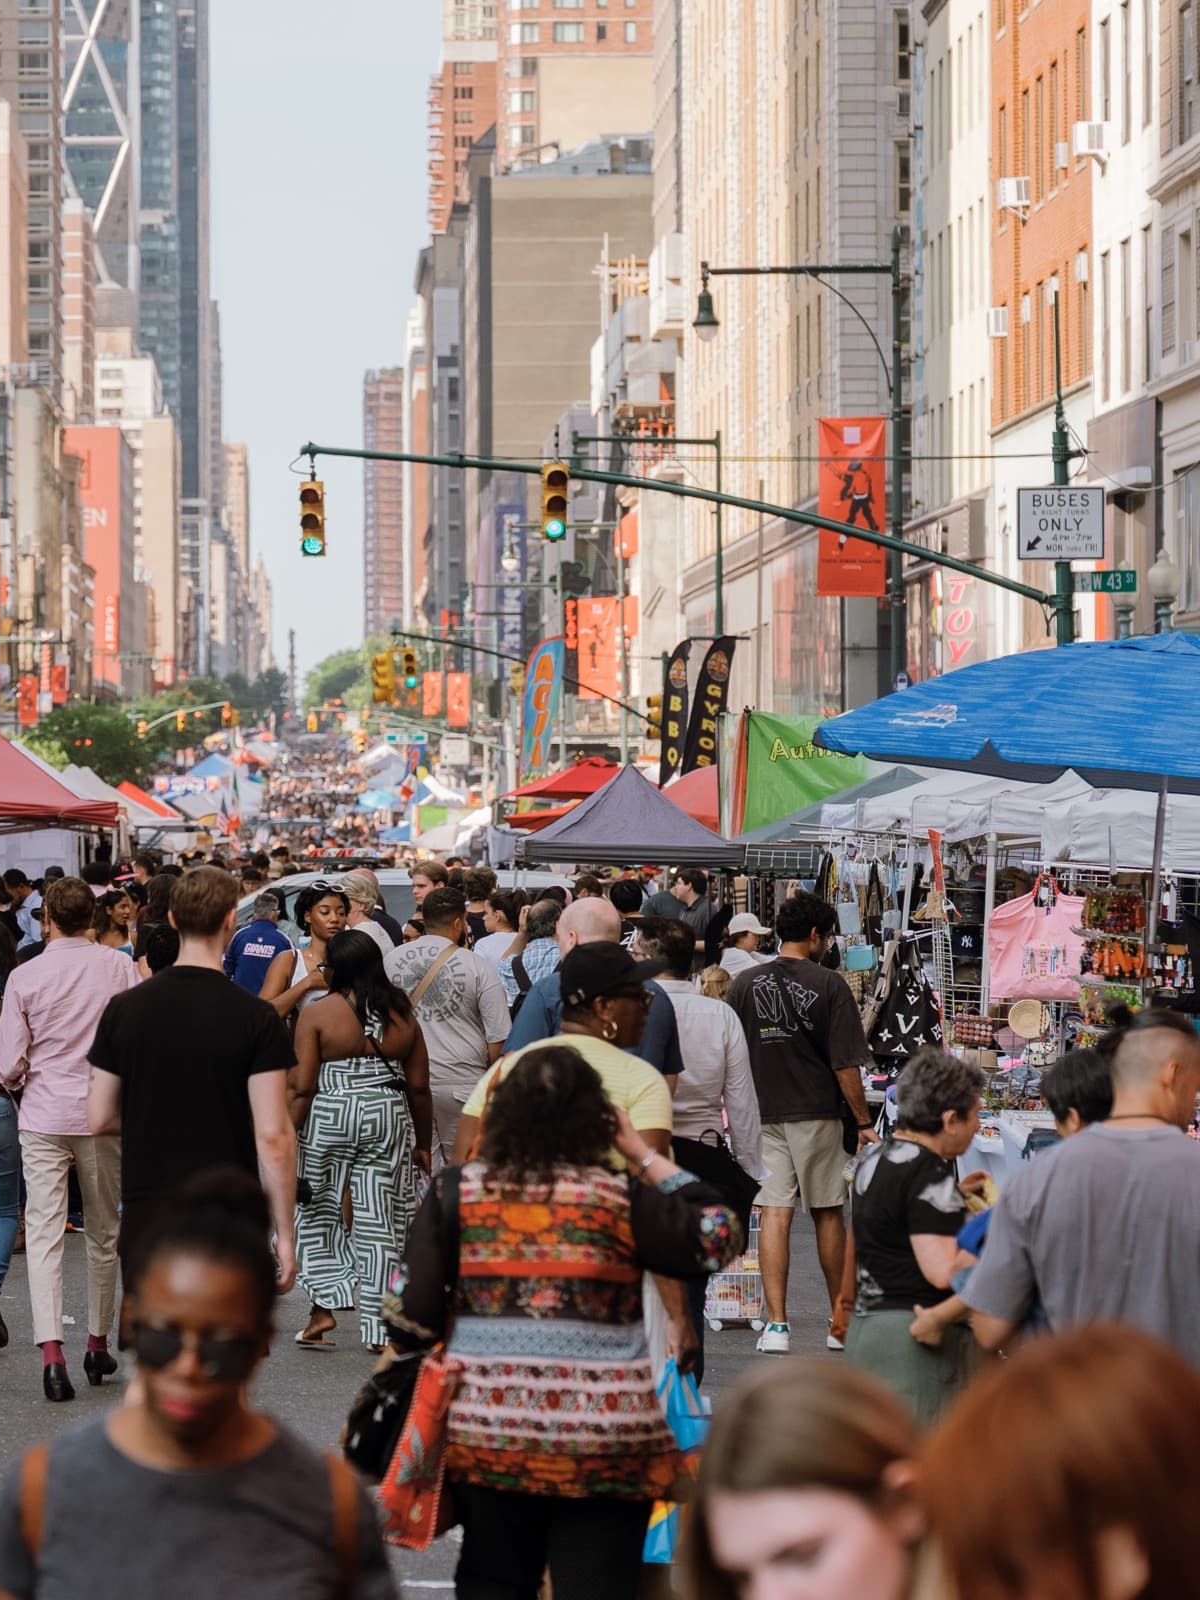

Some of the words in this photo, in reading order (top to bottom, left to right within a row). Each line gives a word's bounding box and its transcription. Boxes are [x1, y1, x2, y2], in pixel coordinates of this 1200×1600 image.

[1032, 493, 1090, 507] BUSES
[1038, 517, 1083, 532] ONLY
[1045, 543, 1063, 552] MON
[1085, 543, 1098, 552] FRI
[1092, 572, 1103, 590] W
[1106, 572, 1122, 590] 43
[1126, 572, 1134, 584] St
[946, 576, 975, 665] TOY
[667, 695, 682, 767] BBQ
[696, 684, 722, 766] GYROS
[243, 943, 276, 956] GIANTS
[395, 946, 425, 970] HOT
[428, 945, 467, 978] CILI
